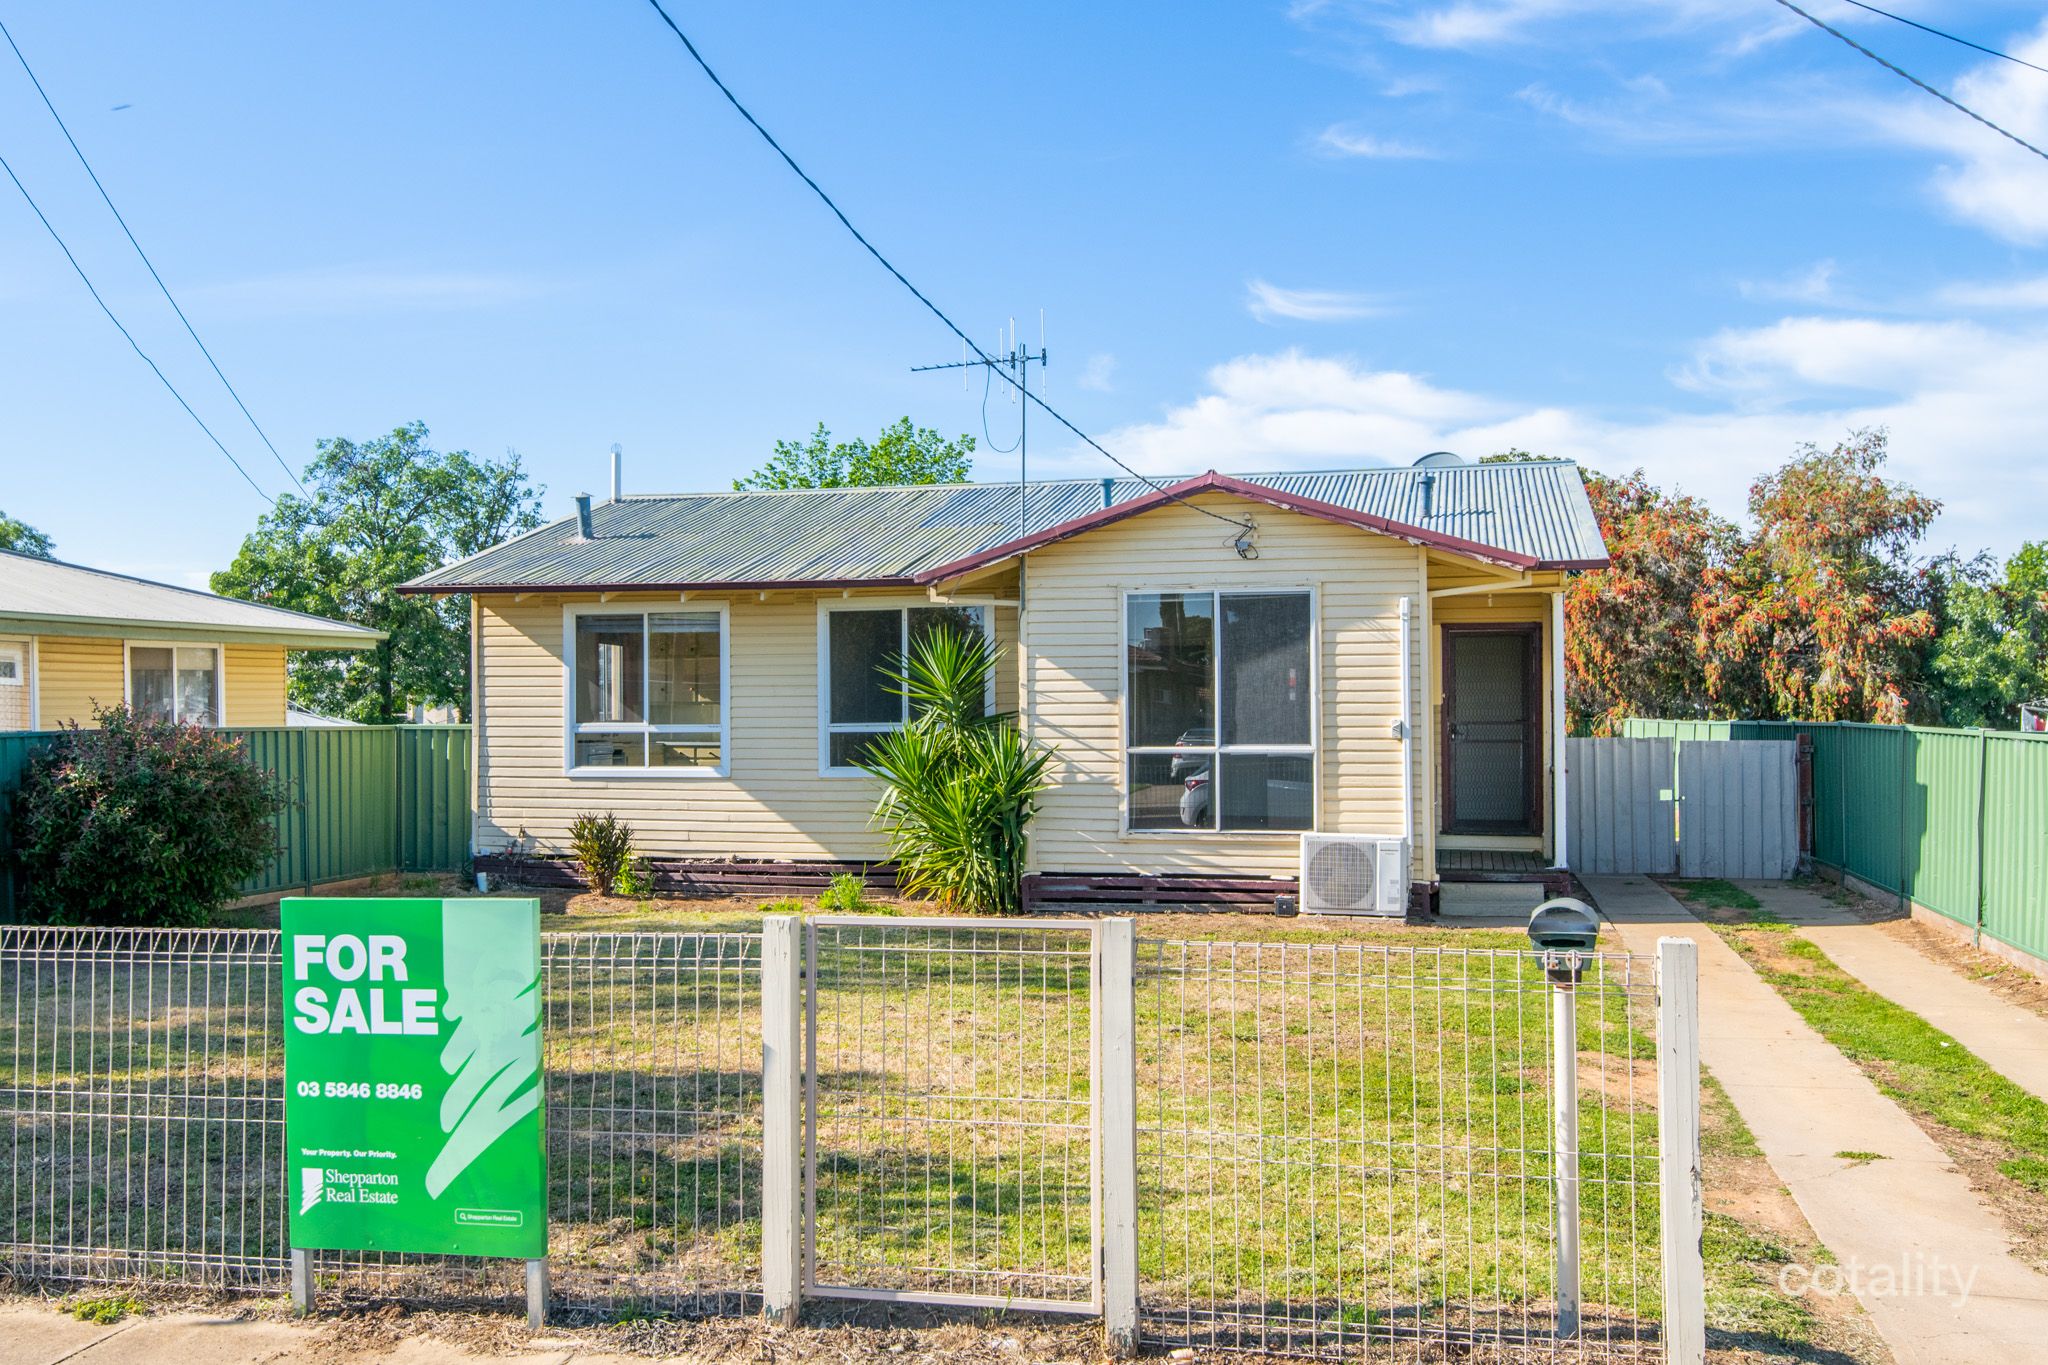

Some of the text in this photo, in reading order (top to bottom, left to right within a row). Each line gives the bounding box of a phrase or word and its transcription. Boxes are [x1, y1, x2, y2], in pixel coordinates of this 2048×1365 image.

[293, 933, 409, 982] FOR
[293, 986, 439, 1035] SALE
[297, 1080, 423, 1100] 03 5846 8846
[301, 1148, 397, 1159] Your Property. Our Priority.
[325, 1168, 399, 1188] Shepparton
[326, 1187, 399, 1204] Real Estate
